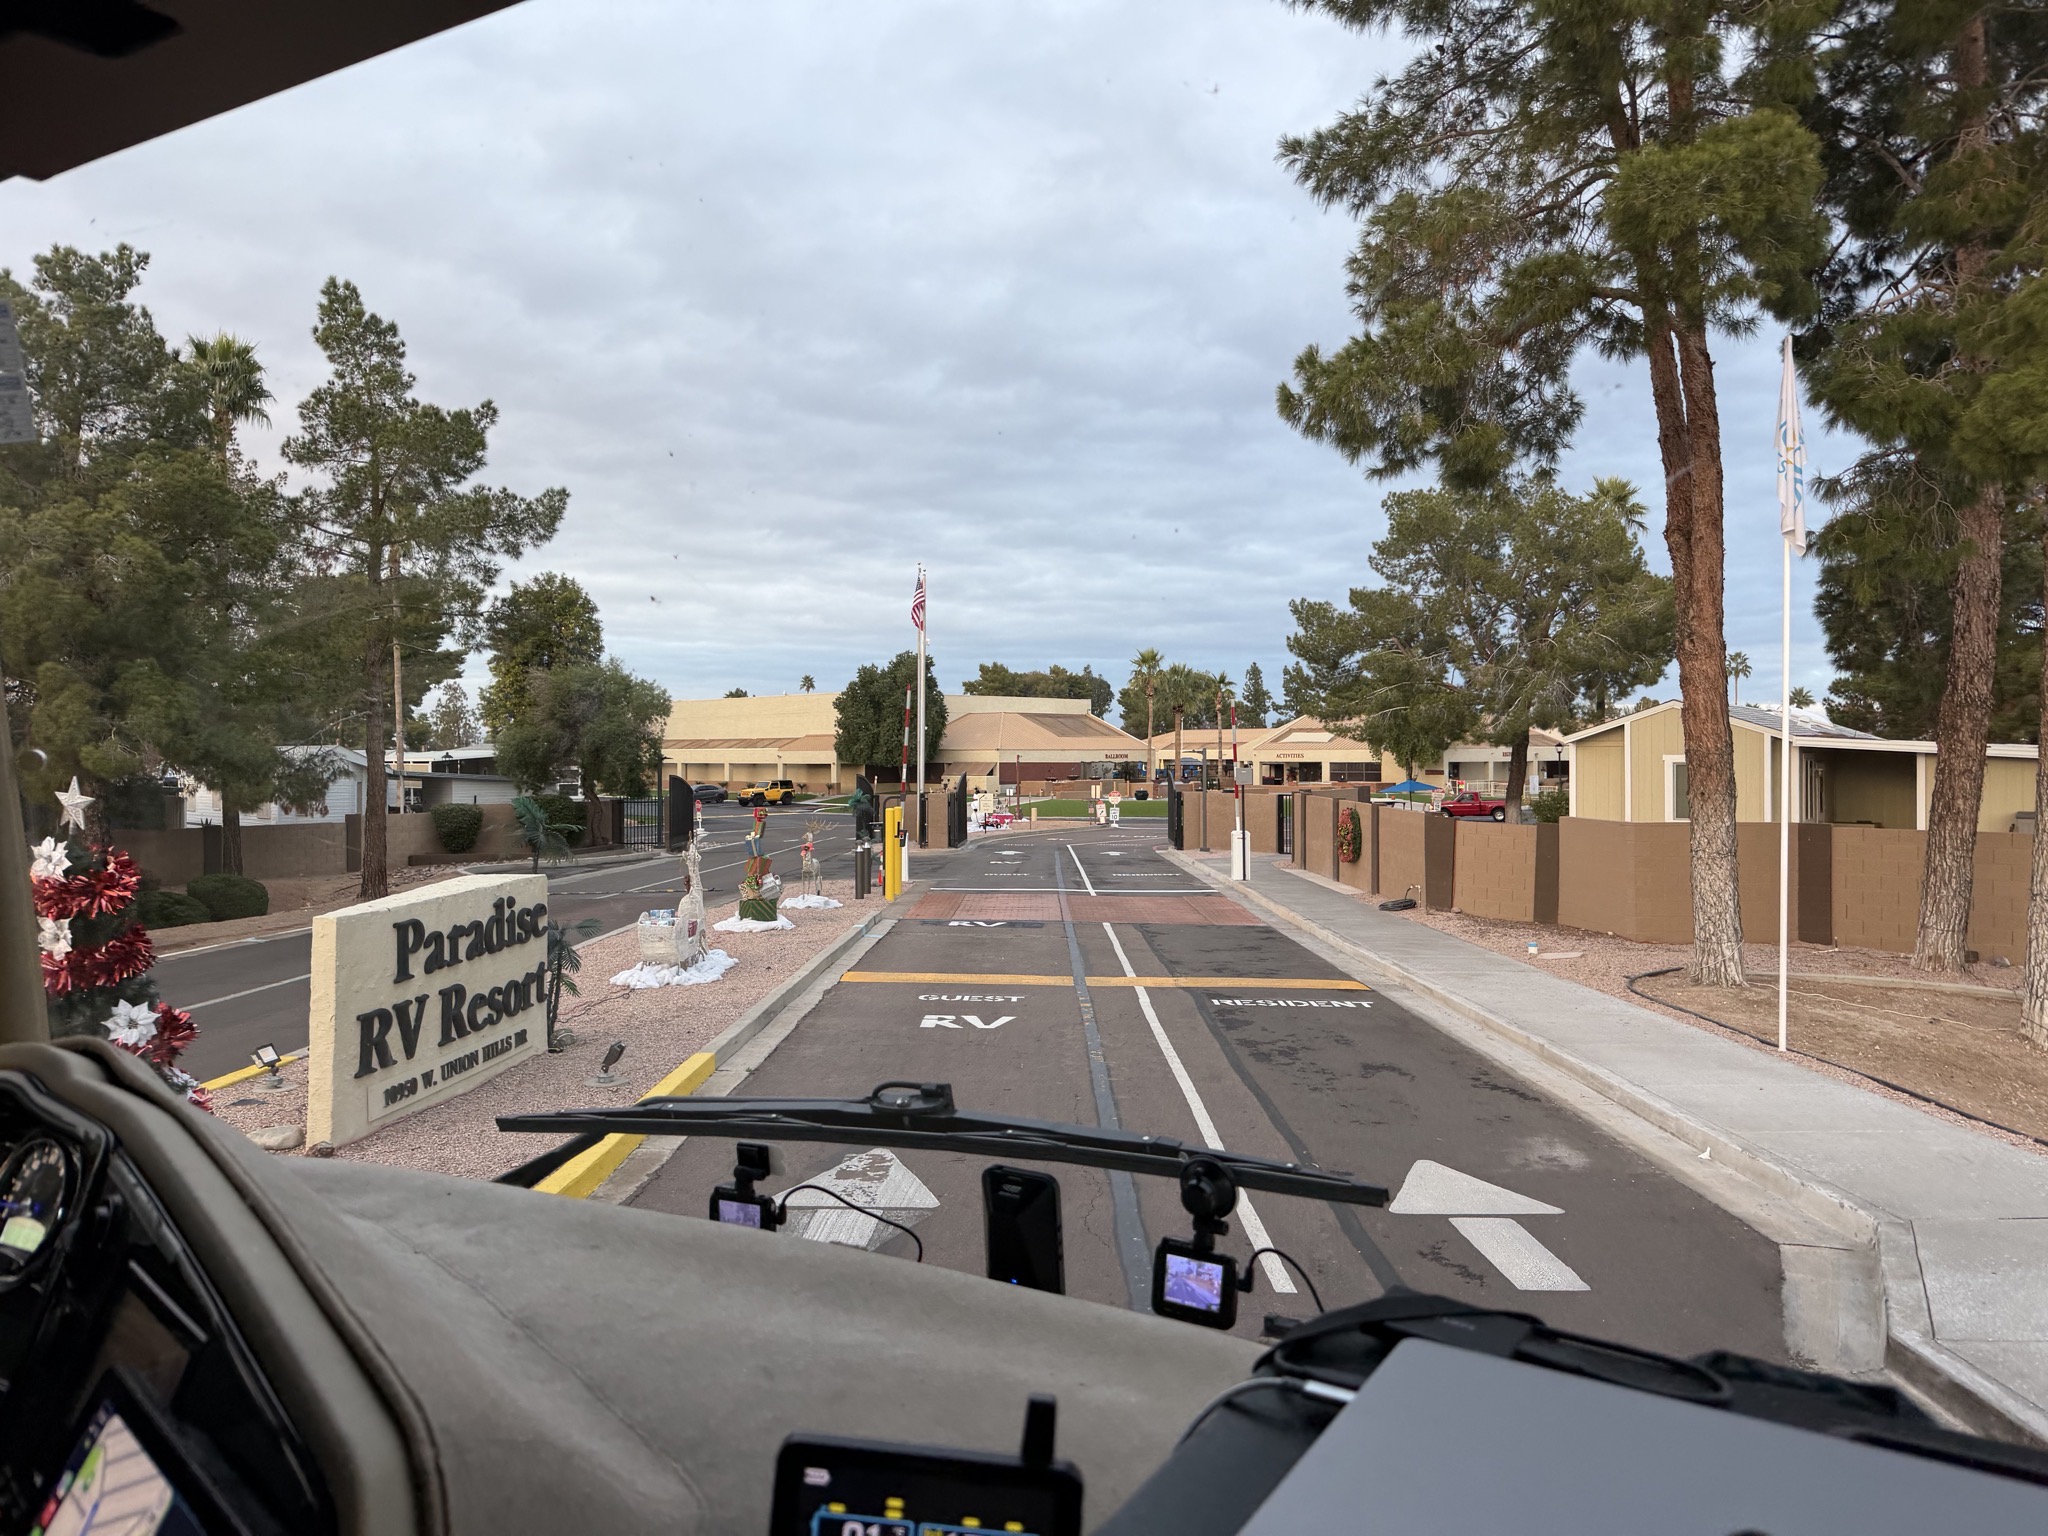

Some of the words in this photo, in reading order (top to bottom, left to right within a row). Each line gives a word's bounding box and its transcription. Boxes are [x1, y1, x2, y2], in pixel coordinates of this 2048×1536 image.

[948, 920, 1007, 928] RV
[392, 895, 548, 985] Paradise
[918, 994, 1026, 1003] GUEST
[1211, 998, 1374, 1009] RESIDENT
[354, 993, 430, 1080] RV
[438, 961, 548, 1048] Resort
[919, 1014, 1018, 1029] RV
[420, 1069, 438, 1090] W.
[440, 1049, 480, 1082] UNION
[481, 1035, 513, 1064] HILLS
[514, 1028, 529, 1049] DR
